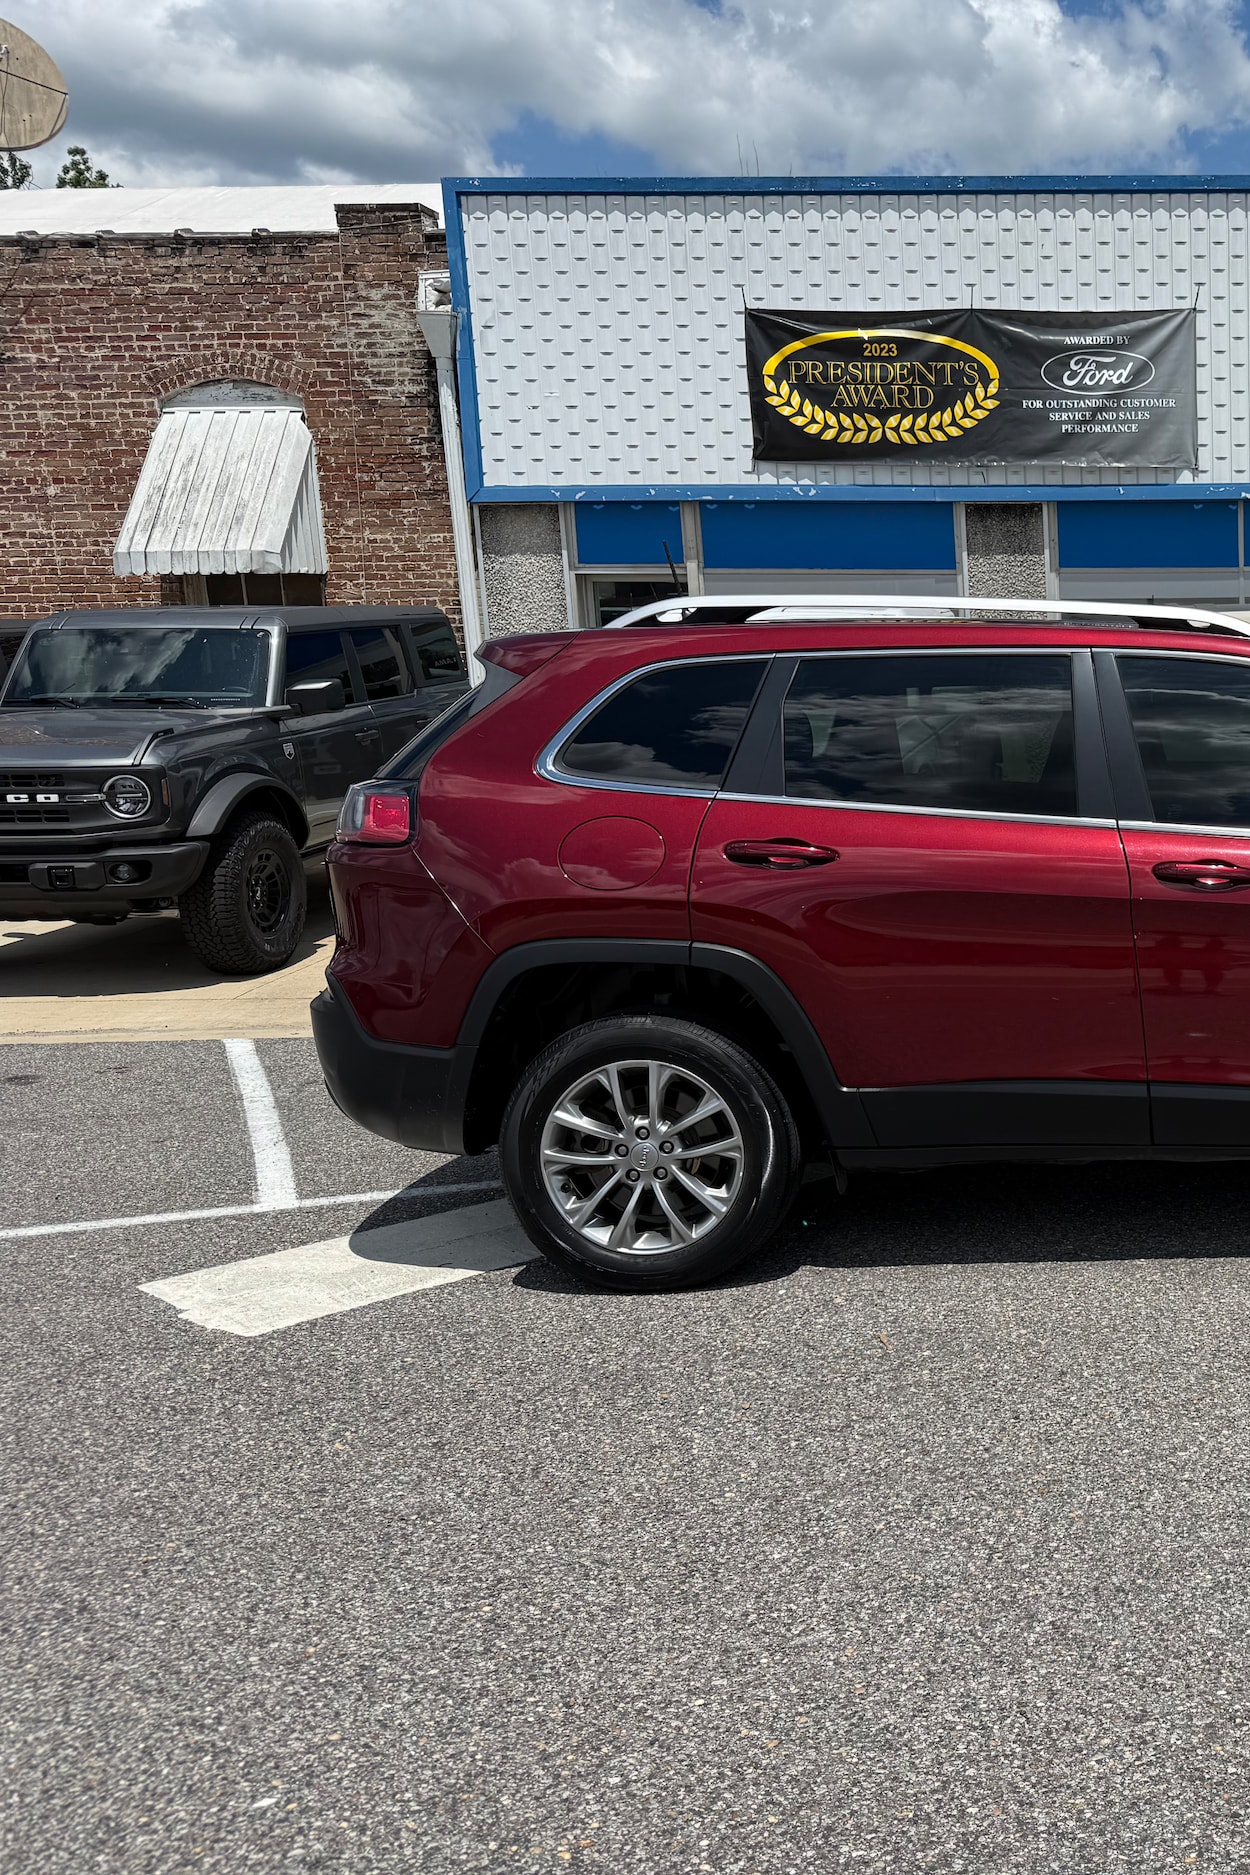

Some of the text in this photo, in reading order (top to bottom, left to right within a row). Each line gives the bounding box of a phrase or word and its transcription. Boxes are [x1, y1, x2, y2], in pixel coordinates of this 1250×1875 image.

[1064, 335, 1130, 345] AWARDED BY
[863, 343, 898, 357] 2023
[788, 360, 980, 386] PRESIDENT'S
[1062, 355, 1134, 386] Ford
[830, 384, 935, 409] AWARD
[1022, 399, 1176, 409] FOR OUTSTANDING CUSTOMER
[1049, 410, 1150, 421] SERVICE AND SALES
[1061, 423, 1139, 433] PERFORMANCE
